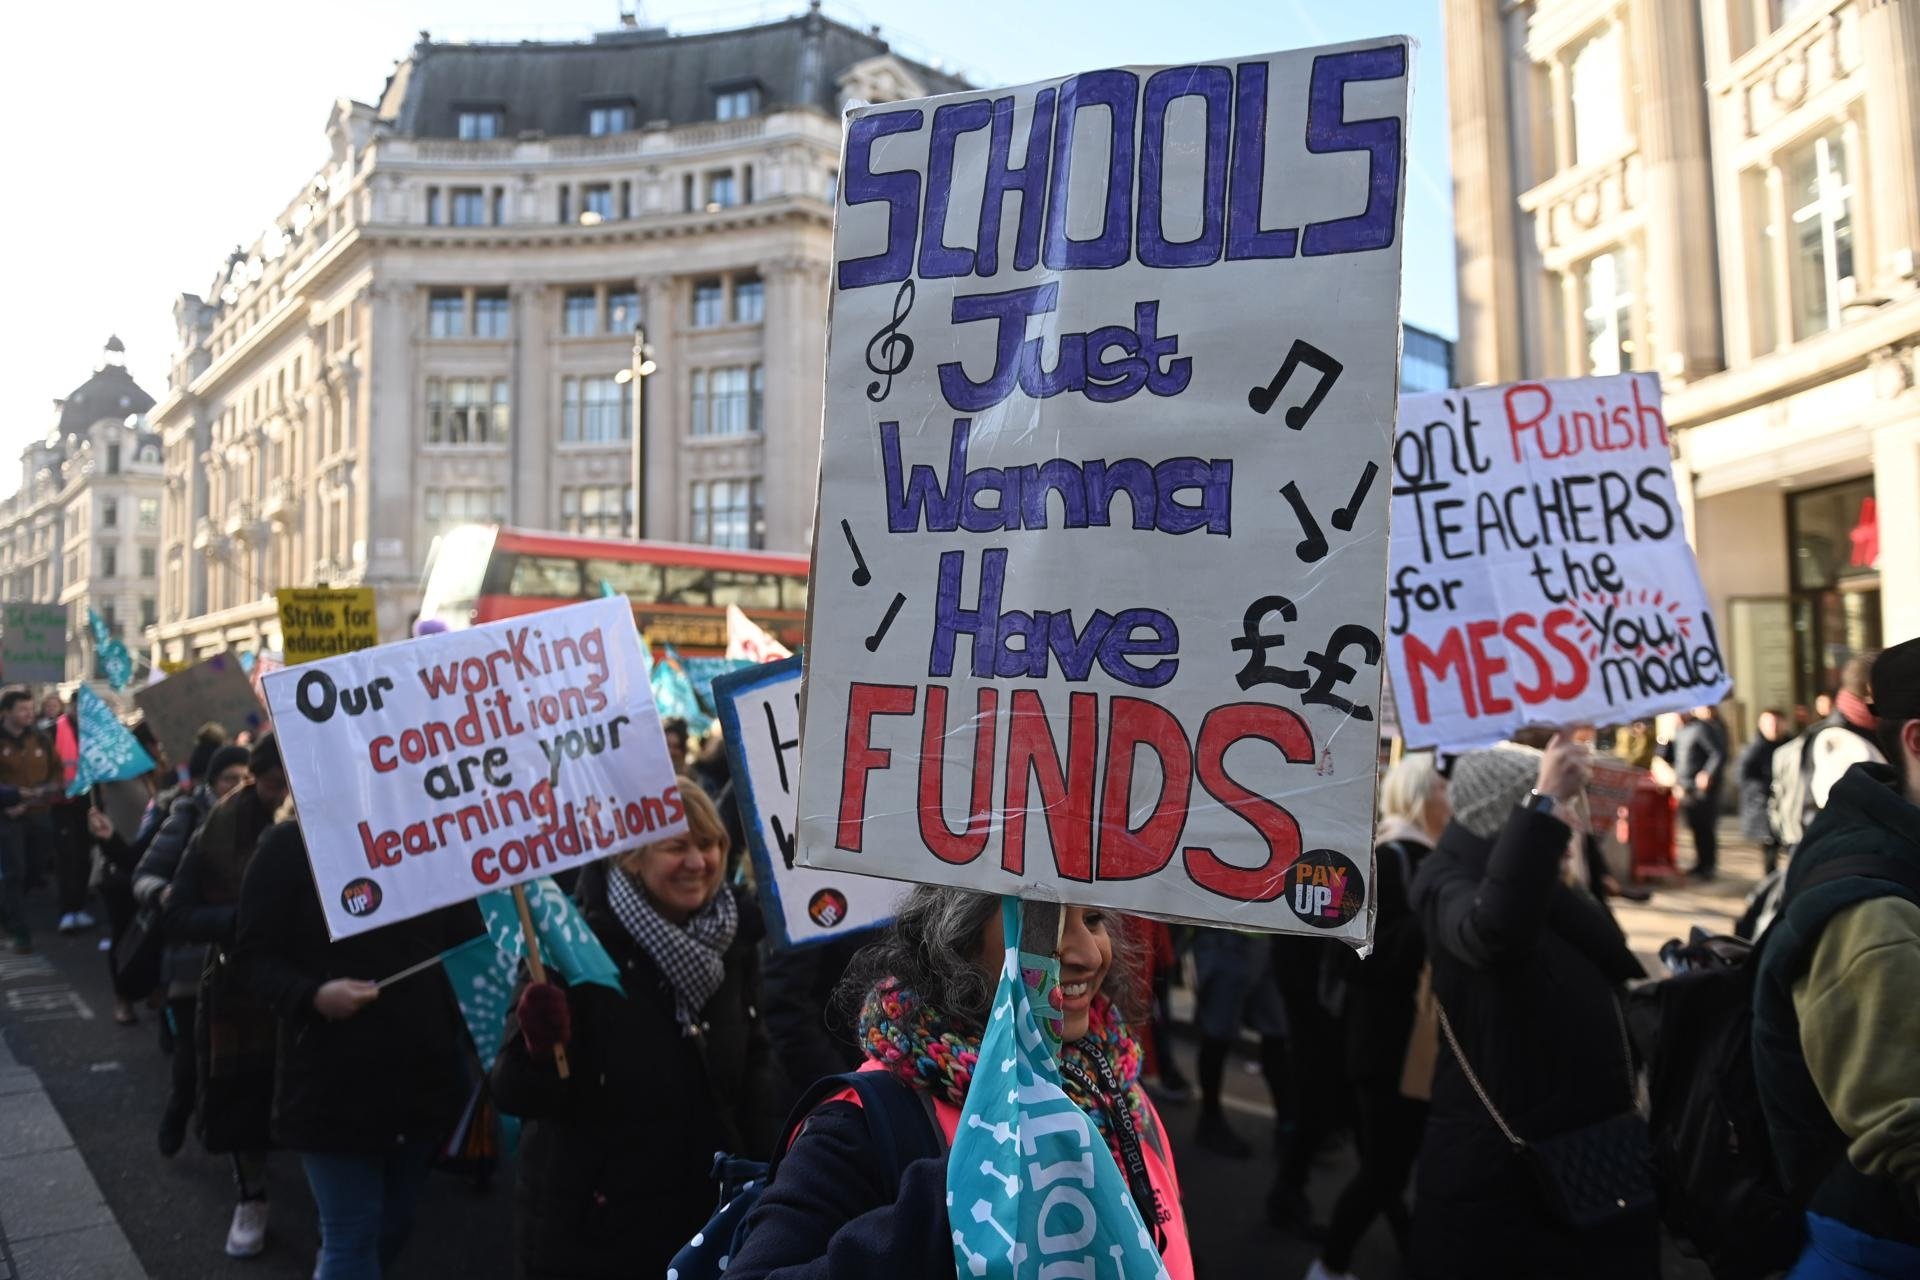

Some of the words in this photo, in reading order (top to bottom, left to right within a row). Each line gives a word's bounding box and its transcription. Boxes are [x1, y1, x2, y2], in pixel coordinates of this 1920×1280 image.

[838, 44, 1406, 290] SCHOOLS
[937, 281, 1193, 412] Just
[879, 418, 1234, 538] Wanna
[1392, 396, 1491, 483] on't
[1504, 378, 1669, 464] Punish
[1392, 467, 1675, 563] TEACHERS
[283, 603, 336, 628] Strike
[343, 603, 372, 627] for
[287, 630, 374, 654] education
[928, 547, 1180, 688] Have
[1390, 566, 1463, 636] for
[1530, 551, 1624, 604] the
[296, 669, 394, 723] Our
[1403, 609, 1590, 725] MESS
[369, 674, 609, 773] conditions
[424, 746, 513, 800] are
[539, 716, 631, 788] your
[358, 777, 560, 870] learning
[472, 785, 686, 885] conditions
[835, 682, 1316, 902] FUNDS
[1295, 863, 1348, 888] PAY
